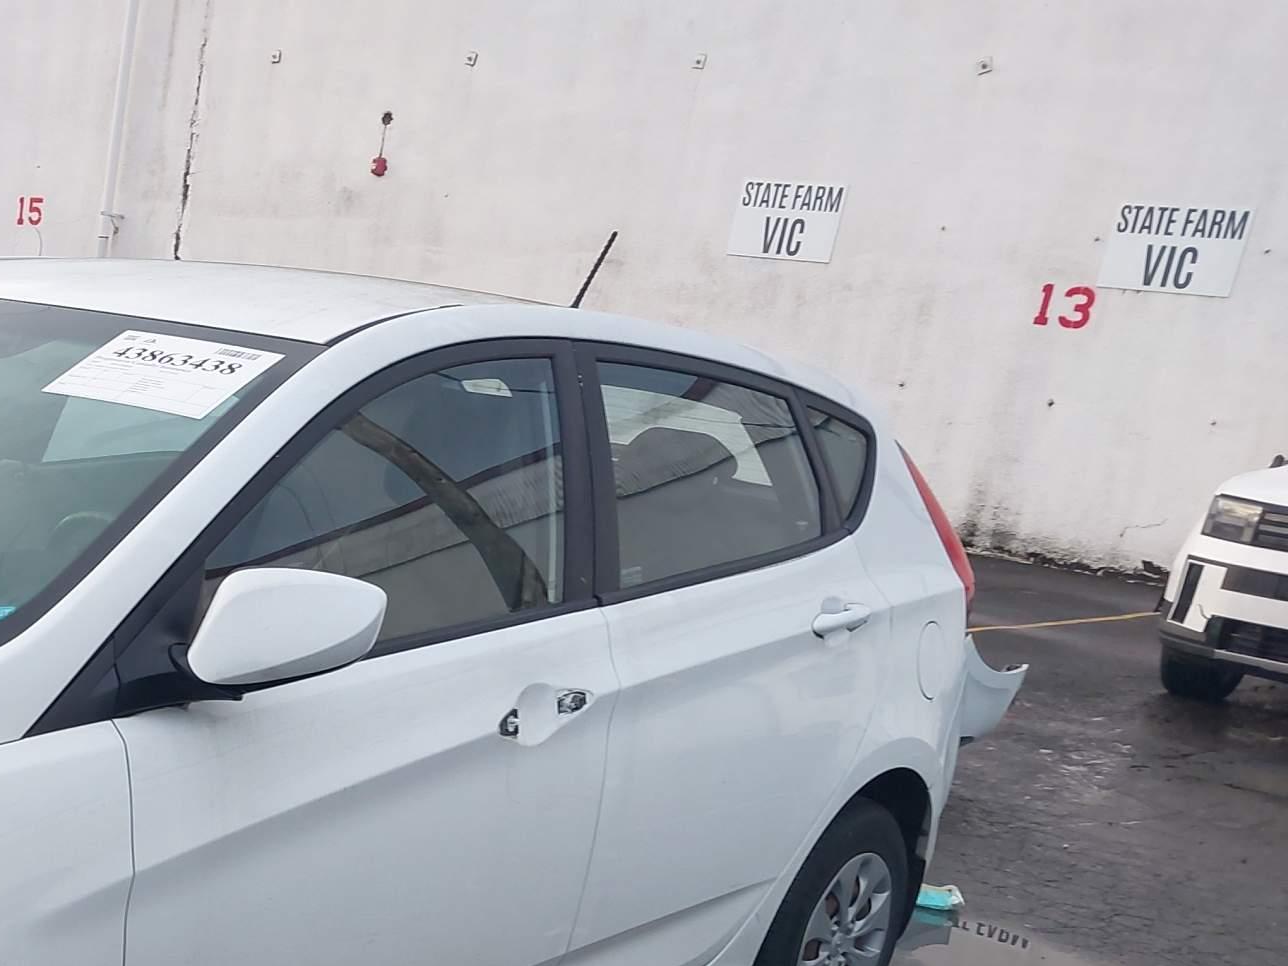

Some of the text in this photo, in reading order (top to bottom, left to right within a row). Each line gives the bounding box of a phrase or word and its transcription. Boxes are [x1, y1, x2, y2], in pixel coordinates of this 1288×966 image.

[17, 196, 44, 226] 15
[742, 181, 845, 213] STATE FARM
[762, 216, 806, 257] VIC
[1116, 204, 1251, 241] STATE FARM
[1142, 244, 1199, 290] VIC
[1033, 283, 1097, 330] 13
[113, 345, 243, 376] 43863438
